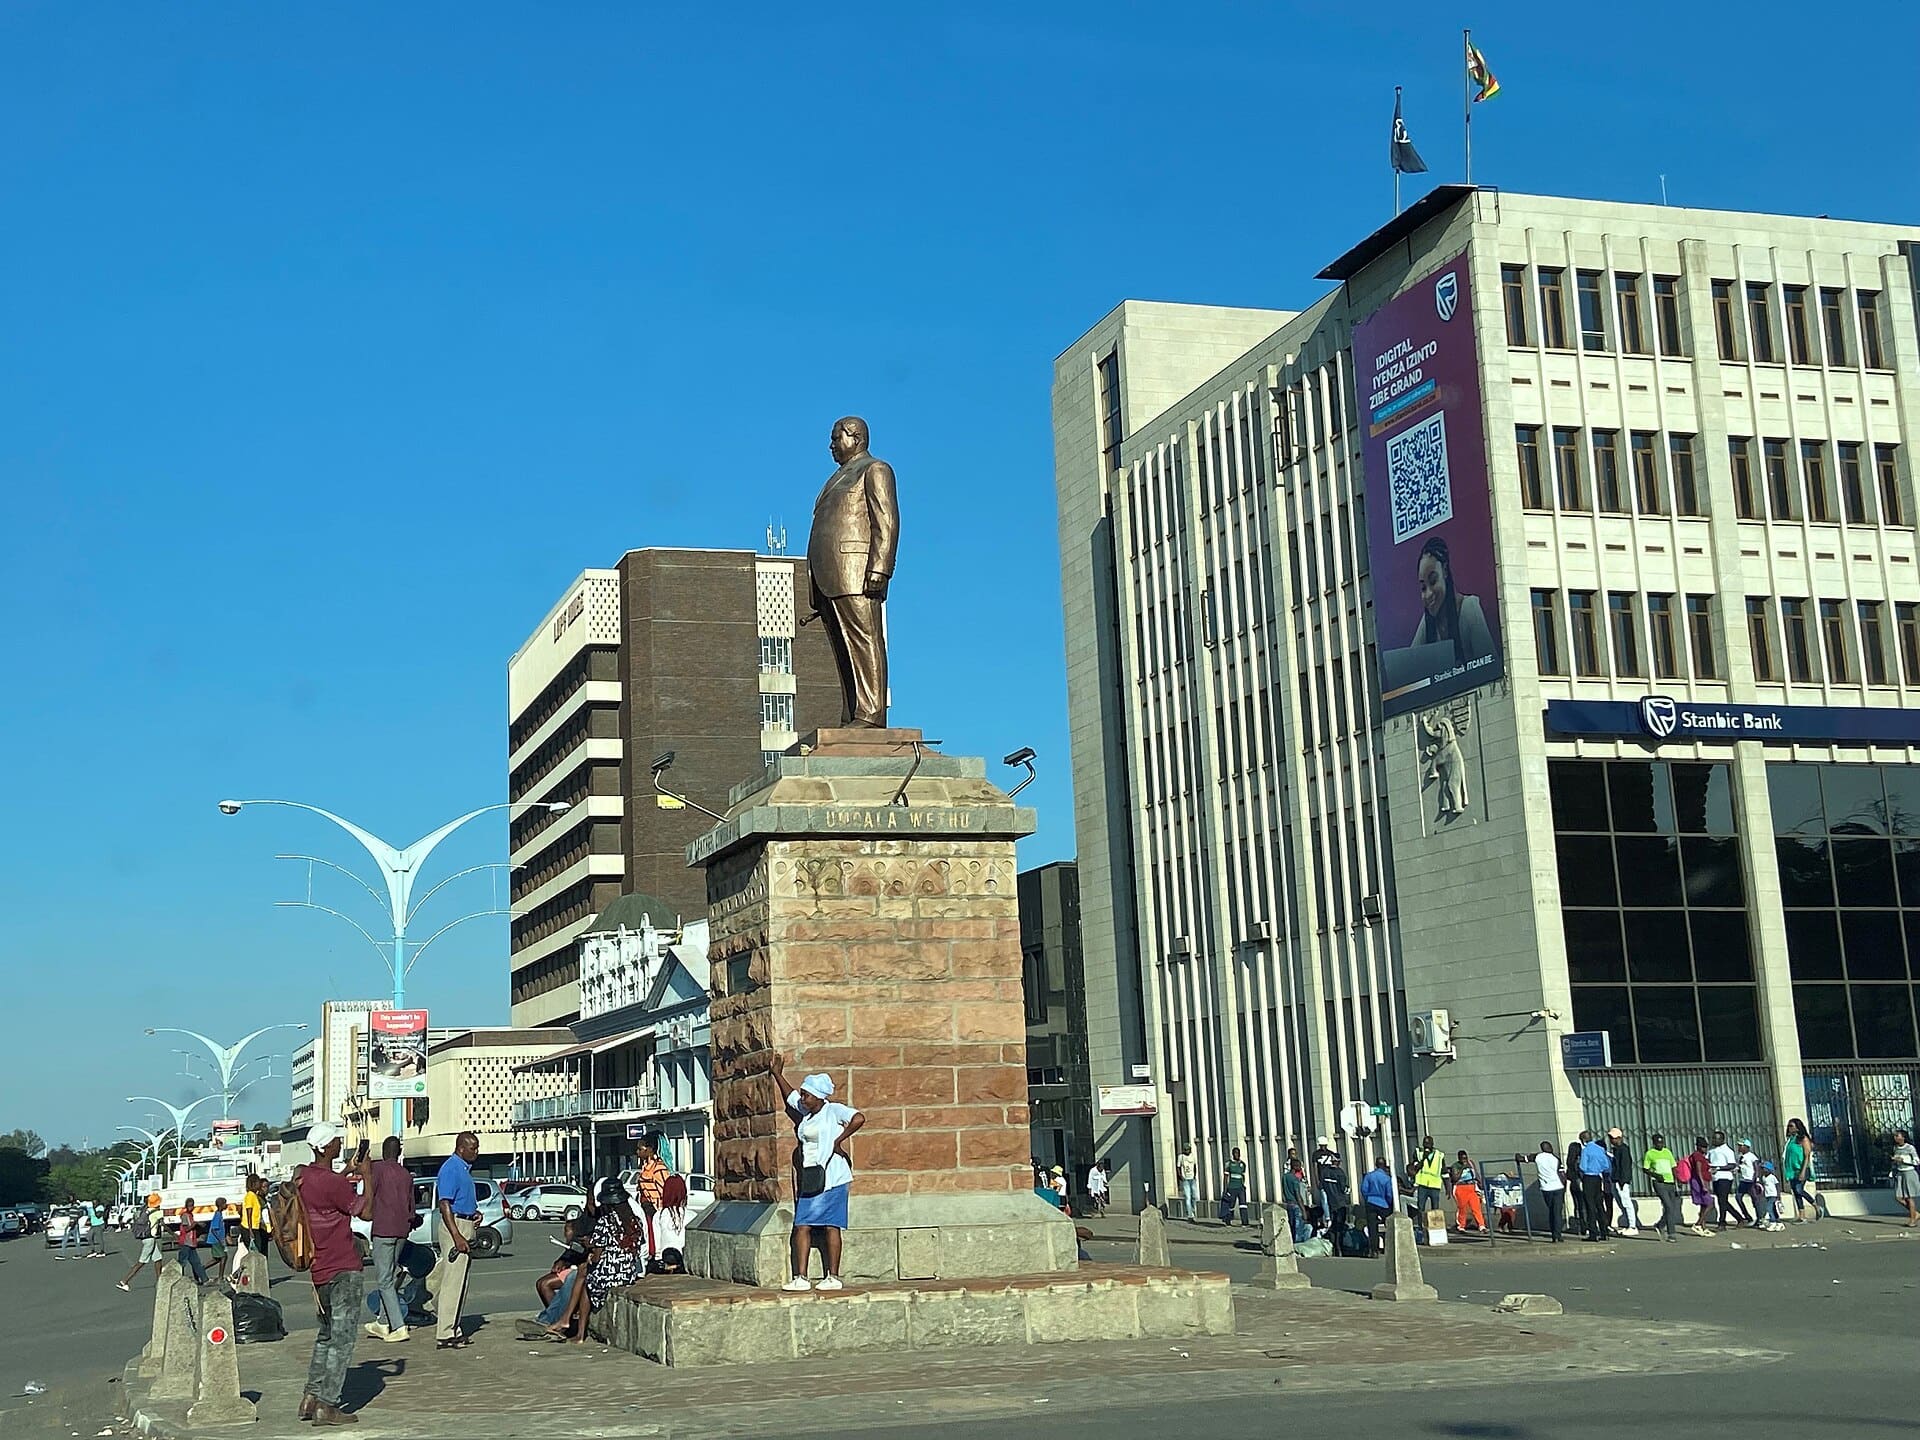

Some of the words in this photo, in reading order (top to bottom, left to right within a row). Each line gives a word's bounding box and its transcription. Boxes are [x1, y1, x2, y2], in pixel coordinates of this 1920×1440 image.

[1373, 360, 1405, 390] IYENZA
[1406, 340, 1437, 370] IZINTO
[1376, 338, 1413, 370] IDIGITAL
[1369, 387, 1390, 410] ZIBE
[1390, 368, 1423, 397] GRAND
[1452, 664, 1466, 676] Bank
[1681, 711, 1741, 729] Stanbic
[1743, 712, 1783, 730] Bank
